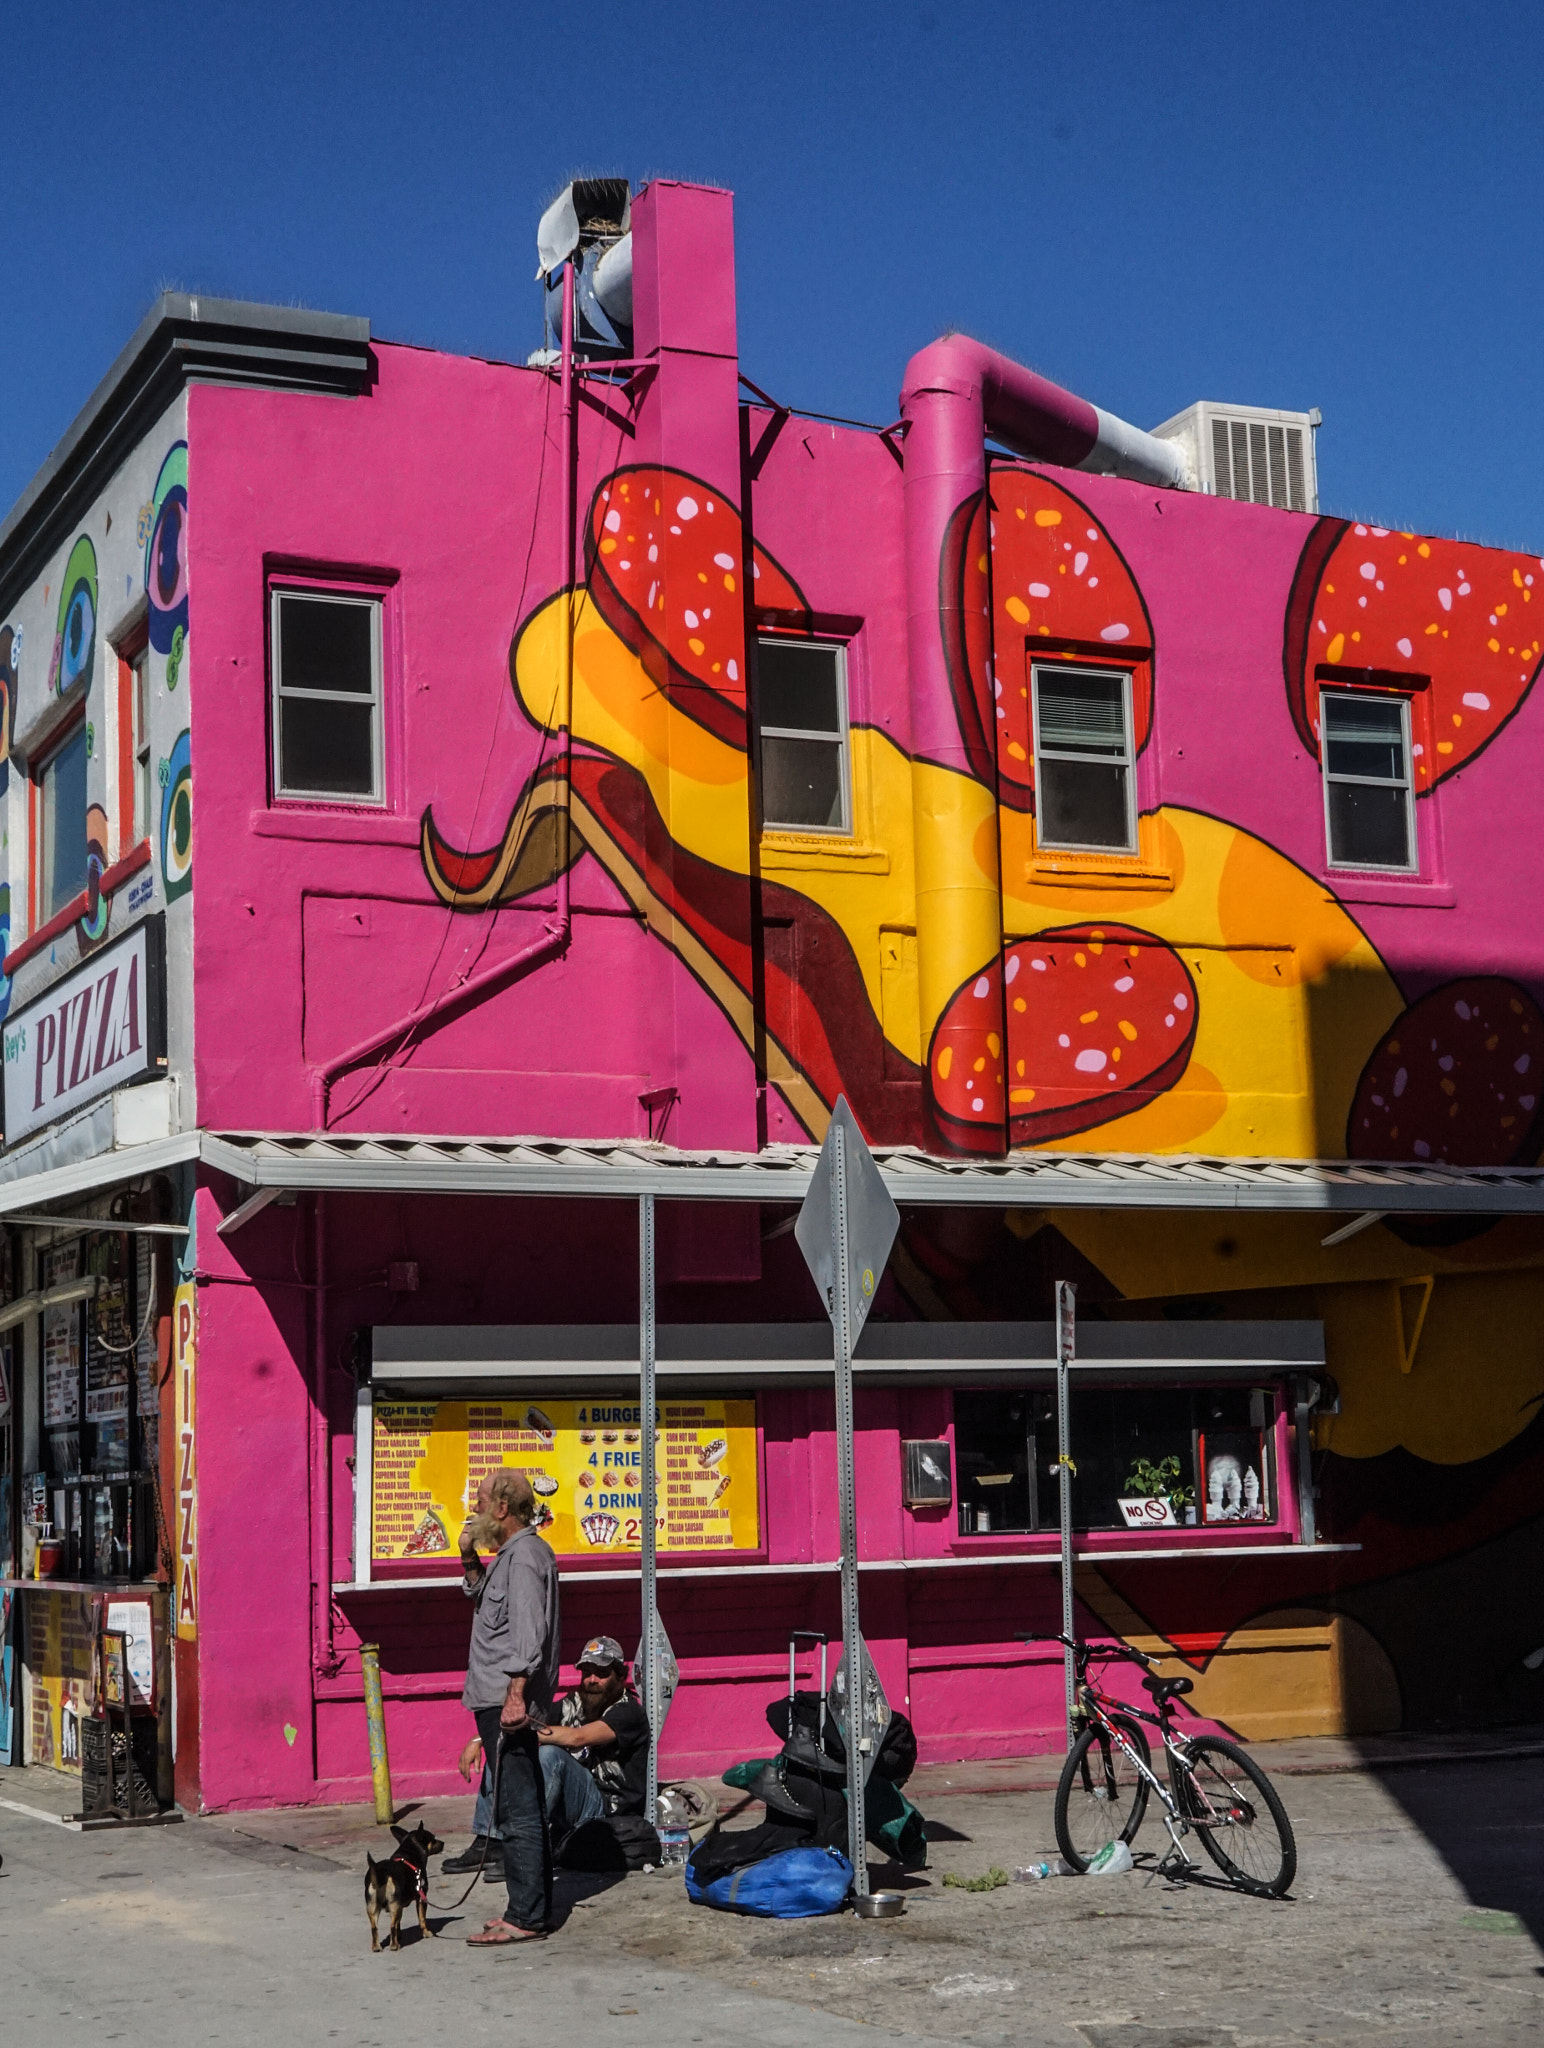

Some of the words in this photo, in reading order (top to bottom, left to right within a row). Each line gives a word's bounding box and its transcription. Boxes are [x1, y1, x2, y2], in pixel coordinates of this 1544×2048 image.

[32, 953, 143, 1112] PIZZA
[578, 1407, 588, 1423] 4
[592, 1407, 661, 1423] BURGES
[468, 1430, 484, 1440] JUMBO
[484, 1430, 501, 1440] CHEESE
[502, 1430, 519, 1440] BURGER
[666, 1432, 678, 1442] CORN
[678, 1432, 688, 1442] HOT
[688, 1432, 697, 1442] DOG
[374, 1439, 389, 1447] FRESH
[390, 1439, 406, 1447] GARLIC
[408, 1439, 420, 1447] SLICE
[468, 1443, 484, 1452] JUMBO
[484, 1443, 502, 1452] DOUBLE
[502, 1443, 519, 1452] CHEESE
[520, 1443, 537, 1452] BURGER
[374, 1450, 390, 1458] CLAMS
[396, 1450, 412, 1458] GARLIC
[413, 1450, 426, 1458] SLICE
[666, 1445, 684, 1455] GRILLED
[684, 1445, 692, 1455] HOT
[177, 1301, 195, 1622] PIZZA
[374, 1460, 402, 1468] VEGETARIAN
[403, 1460, 416, 1468] SLICE
[468, 1455, 484, 1464] VEGGIE
[485, 1455, 503, 1464] BURGER
[588, 1452, 598, 1467] 4
[604, 1452, 642, 1467] FRIE
[666, 1458, 678, 1468] CHILI
[678, 1458, 688, 1468] DOG
[374, 1471, 396, 1479] SUPREME
[397, 1471, 410, 1479] SLICE
[468, 1467, 486, 1476] SHRIMP
[666, 1471, 682, 1480] JUMBO
[682, 1471, 694, 1480] CHILI
[694, 1471, 710, 1480] CHEESE
[375, 1481, 396, 1489] GARBAGE
[397, 1481, 410, 1489] SLICE
[667, 1484, 679, 1494] CHILI
[679, 1484, 692, 1494] FRIES
[384, 1492, 393, 1500] AND
[394, 1492, 418, 1500] PINEAPPLE
[419, 1492, 432, 1500] SLICE
[376, 1502, 392, 1510] CRISPY
[393, 1502, 413, 1510] CHICKEN
[414, 1502, 430, 1510] STRIPS
[584, 1494, 594, 1509] 4
[599, 1494, 658, 1509] DRIN
[667, 1497, 679, 1506] CHILI
[679, 1497, 695, 1506] CHEESE
[696, 1497, 708, 1506] FRIES
[667, 1510, 676, 1519] HOT
[677, 1510, 700, 1519] LOUISIANA
[700, 1510, 719, 1519] SAUSAGE
[1125, 1506, 1143, 1517] NO
[375, 1524, 401, 1532] MEATBALLS
[402, 1524, 415, 1532] BOWL
[667, 1523, 684, 1532] ITALIAN
[684, 1523, 704, 1532] SAUSAGE
[376, 1534, 390, 1543] LARGE
[390, 1534, 408, 1543] FRENCH
[668, 1535, 684, 1545] ITALIAN
[685, 1535, 704, 1545] CHICKEN
[704, 1535, 724, 1545] SAUSAGE
